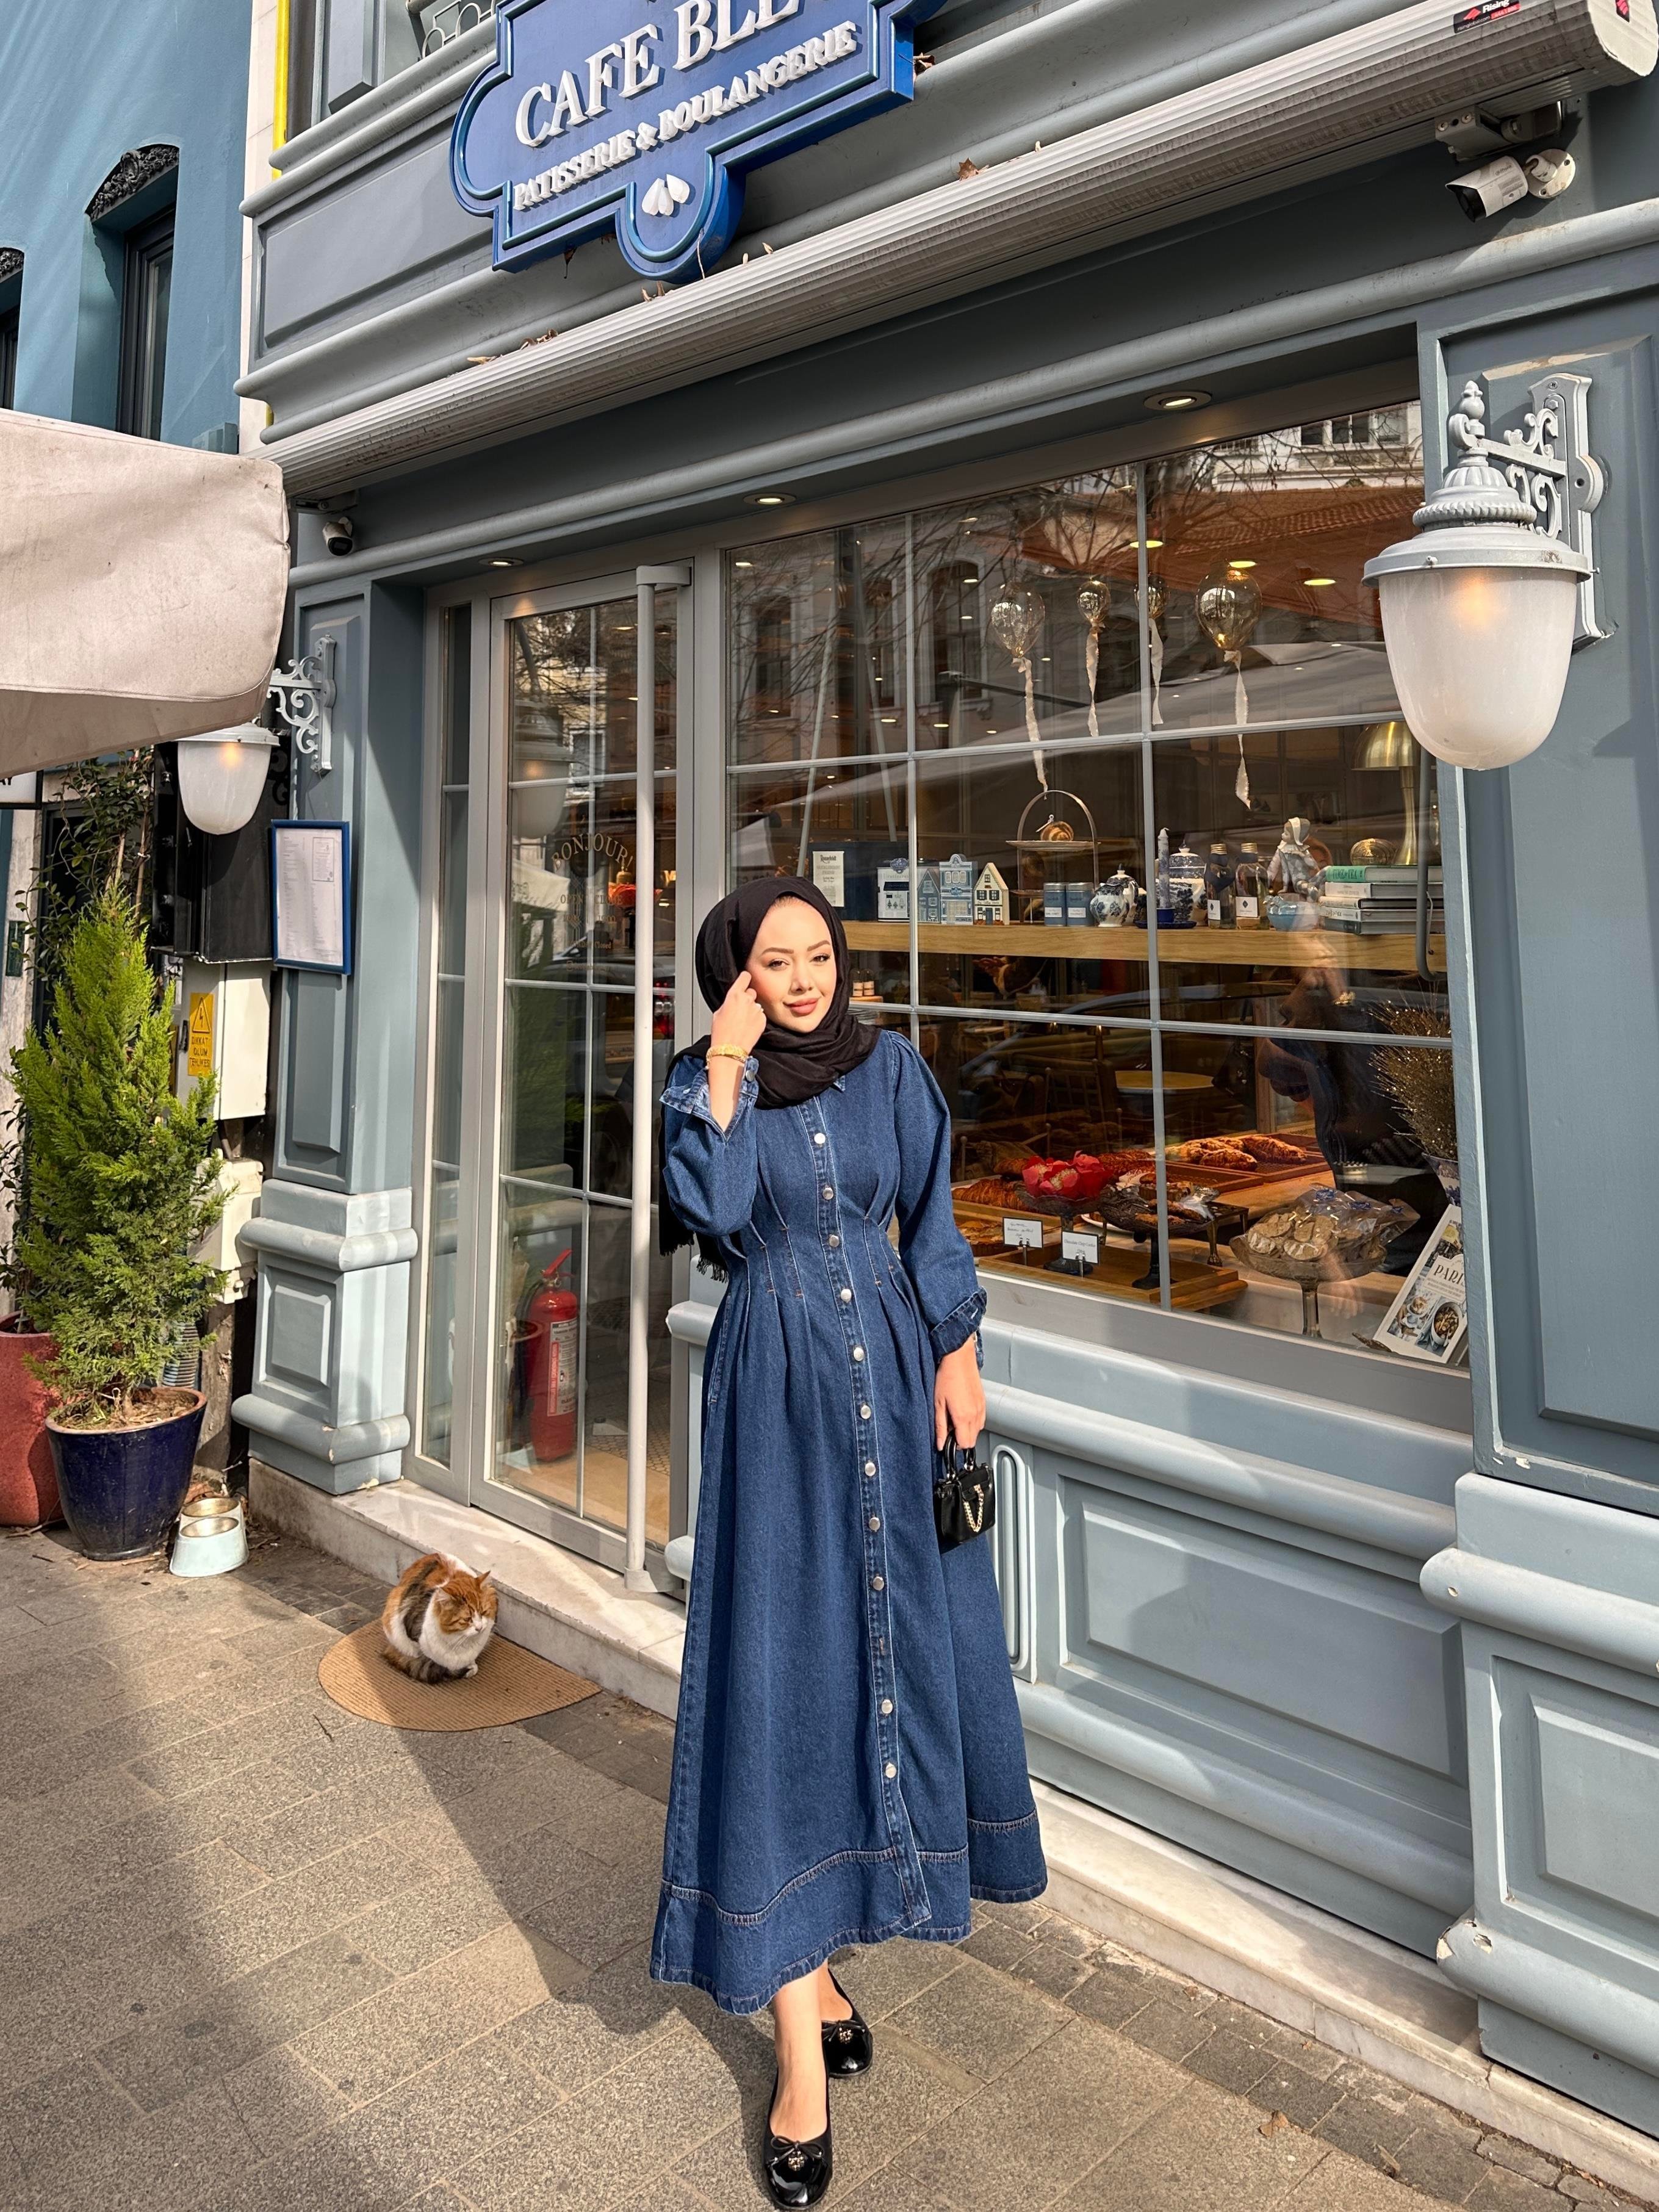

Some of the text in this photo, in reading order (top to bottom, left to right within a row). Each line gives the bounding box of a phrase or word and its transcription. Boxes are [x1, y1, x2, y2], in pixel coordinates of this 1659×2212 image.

[1483, 0, 1510, 13] Rising
[513, 20, 856, 211] PATISSERIE & BOULANGERIE
[516, 23, 660, 147] CAFE
